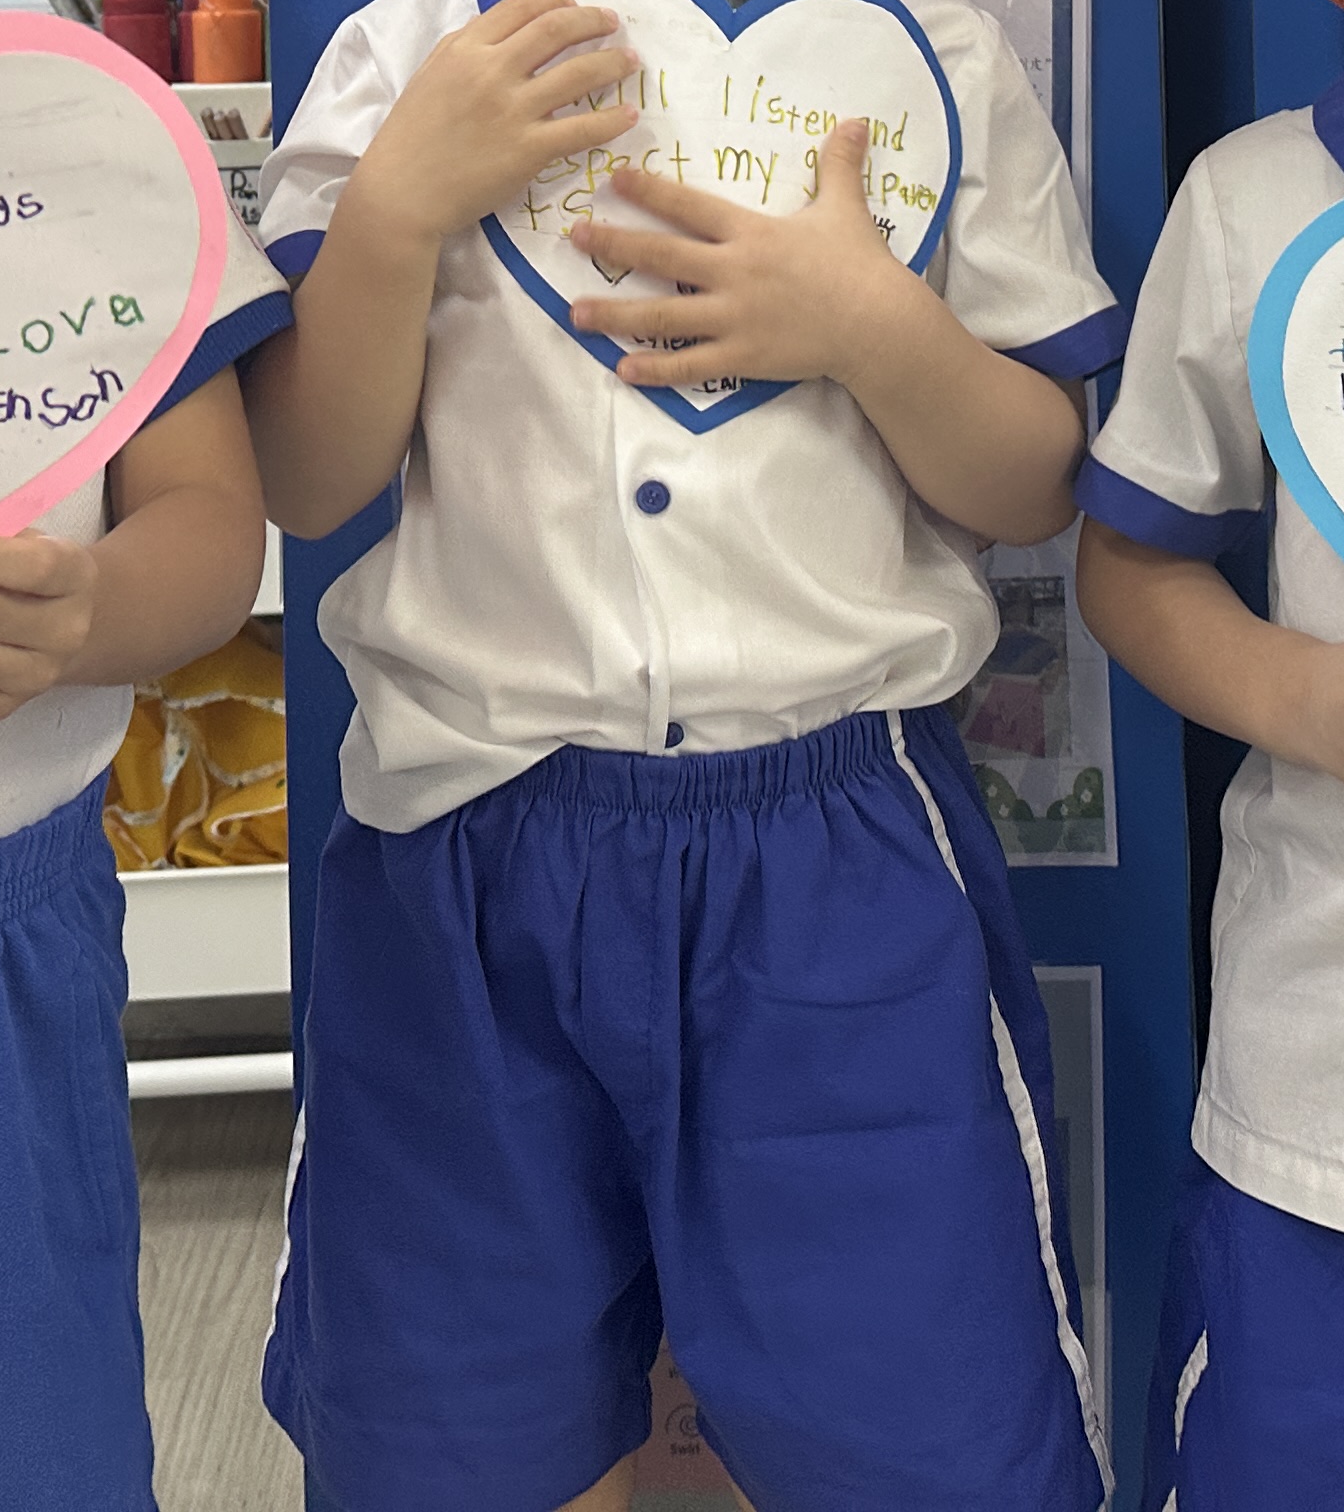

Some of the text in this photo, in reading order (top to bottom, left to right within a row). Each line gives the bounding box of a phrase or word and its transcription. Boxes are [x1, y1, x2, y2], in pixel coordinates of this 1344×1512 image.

[724, 74, 838, 136] listen
[853, 110, 909, 153] nd
[535, 140, 692, 195] espect
[713, 145, 780, 206] my
